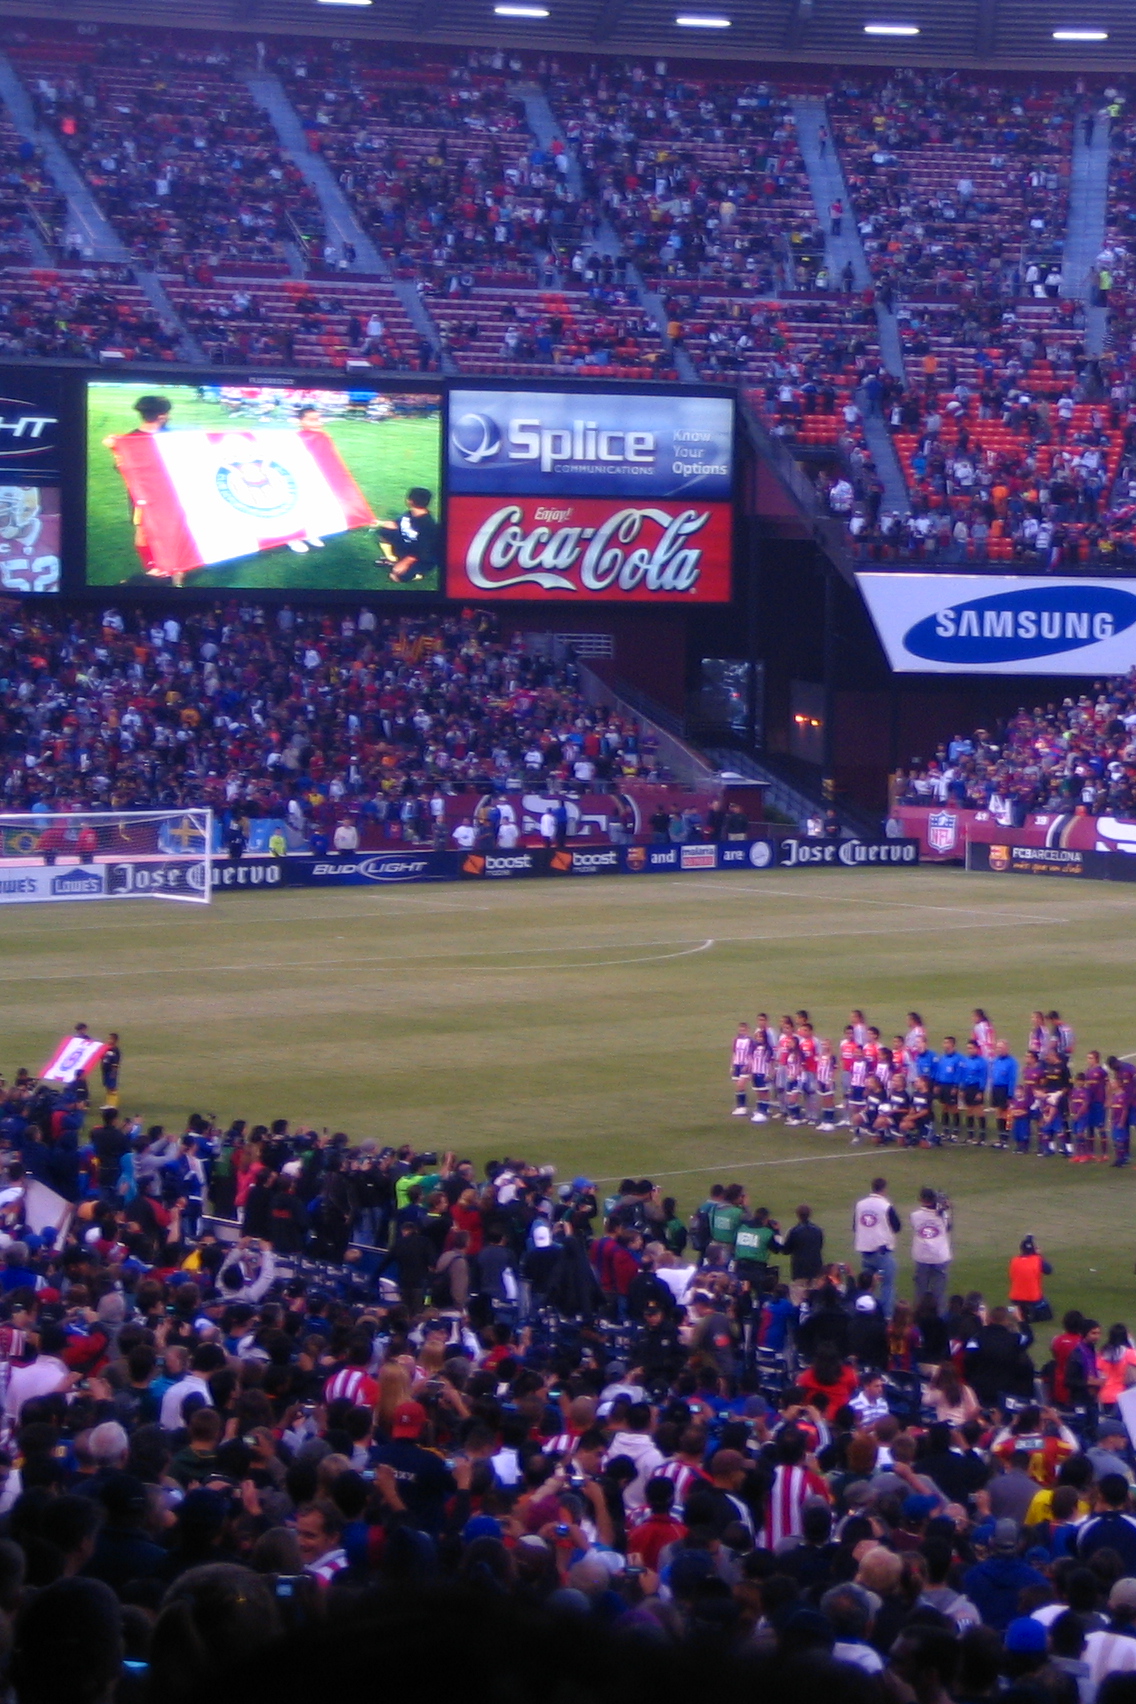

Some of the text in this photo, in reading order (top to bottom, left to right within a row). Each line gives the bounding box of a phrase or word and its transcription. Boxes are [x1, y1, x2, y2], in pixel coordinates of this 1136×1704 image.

[673, 430, 711, 442] Know
[508, 418, 656, 473] Splice
[673, 444, 705, 458] Your
[553, 464, 654, 475] COMMUNICATIONS
[672, 461, 728, 478] Options
[534, 506, 574, 523] Enjoy!
[465, 505, 711, 592] Coca-Cola
[935, 608, 1115, 640] SAMSUNG
[485, 853, 532, 869] boost
[572, 851, 618, 866] boost
[650, 849, 745, 864] and are
[780, 839, 916, 867] Jose Cuervo
[312, 861, 428, 876] BUD LIGHT
[54, 878, 99, 893] LOWE'S
[113, 862, 281, 893] Jose Cuervo
